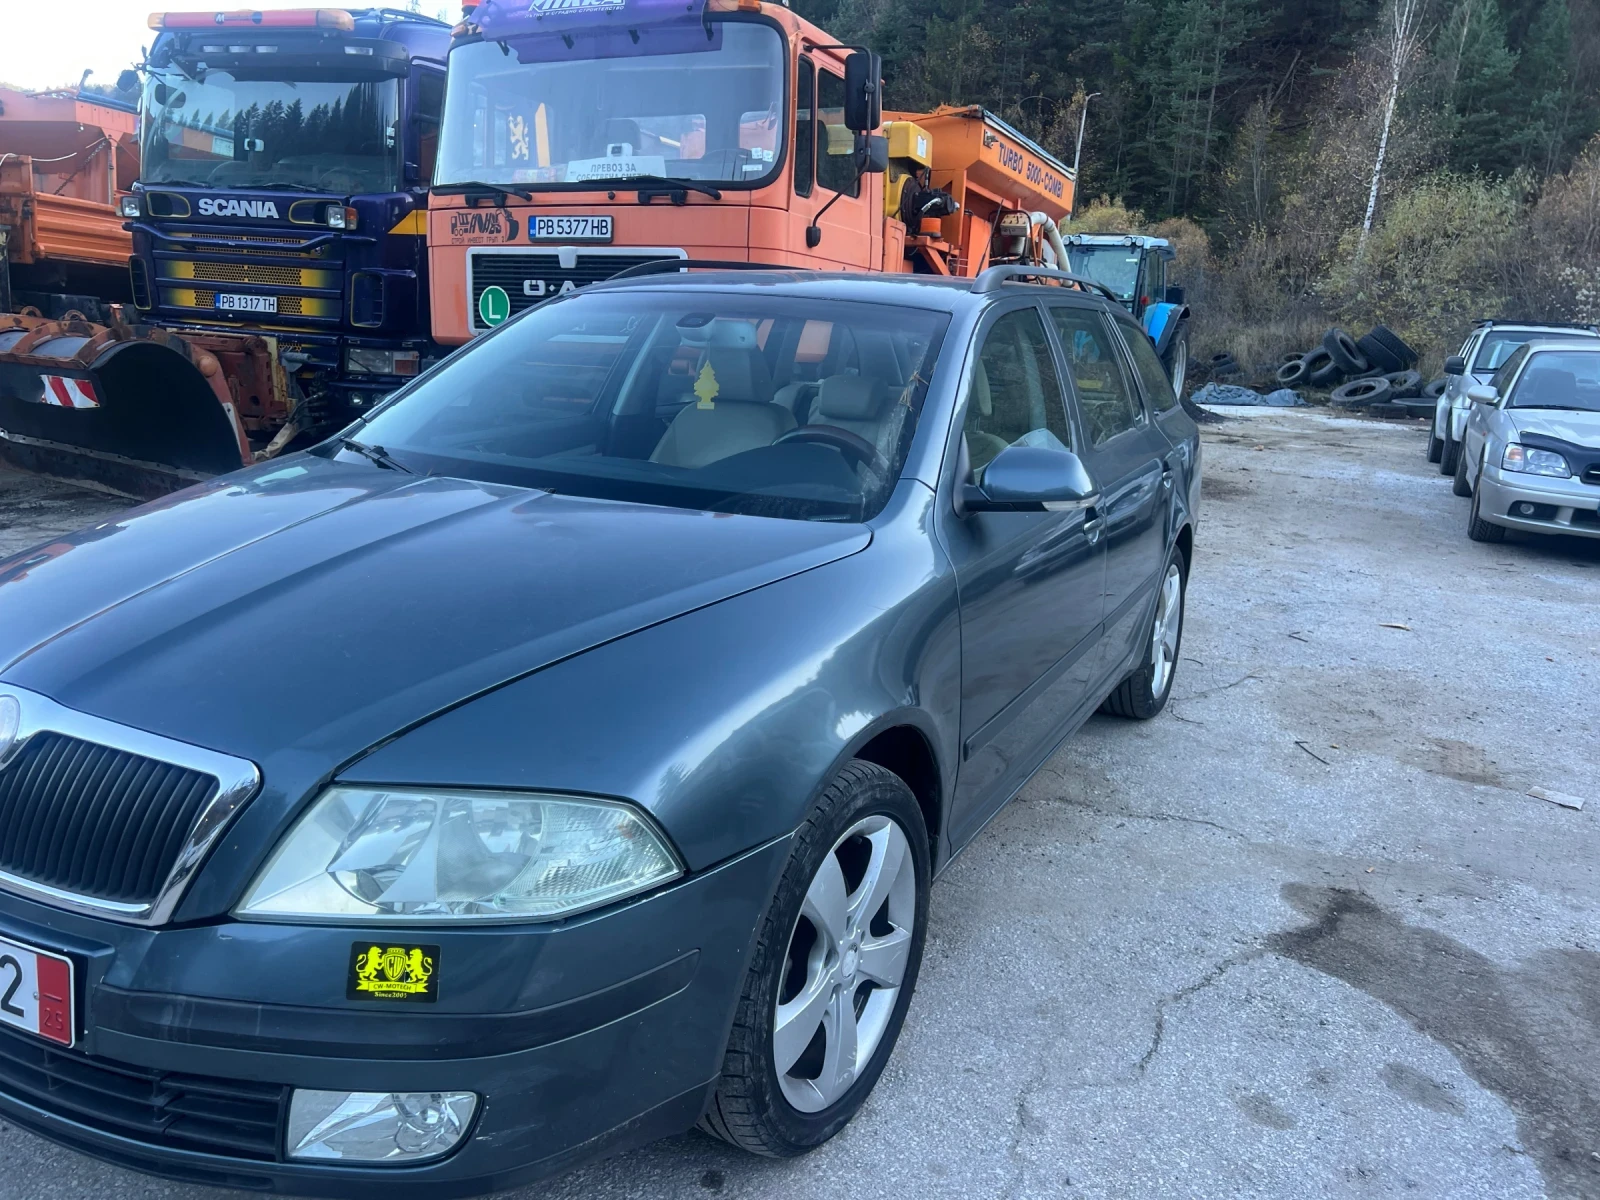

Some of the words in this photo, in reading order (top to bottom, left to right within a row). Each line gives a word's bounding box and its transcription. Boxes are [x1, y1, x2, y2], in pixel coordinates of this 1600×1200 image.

[590, 163, 623, 173] ПРЕВОЗ
[625, 163, 637, 172] ЗА
[998, 142, 1024, 175] TURBO
[1026, 161, 1064, 200] 5000-COMBI
[198, 198, 280, 219] SCANIA
[537, 219, 555, 236] PB
[556, 219, 589, 236] 5377
[590, 219, 609, 236] HB
[221, 295, 235, 308] PB
[237, 296, 260, 310] 1317
[262, 298, 275, 311] TH
[488, 294, 501, 319] L
[0, 954, 25, 1018] 2
[373, 983, 412, 991] CW-MOTECH
